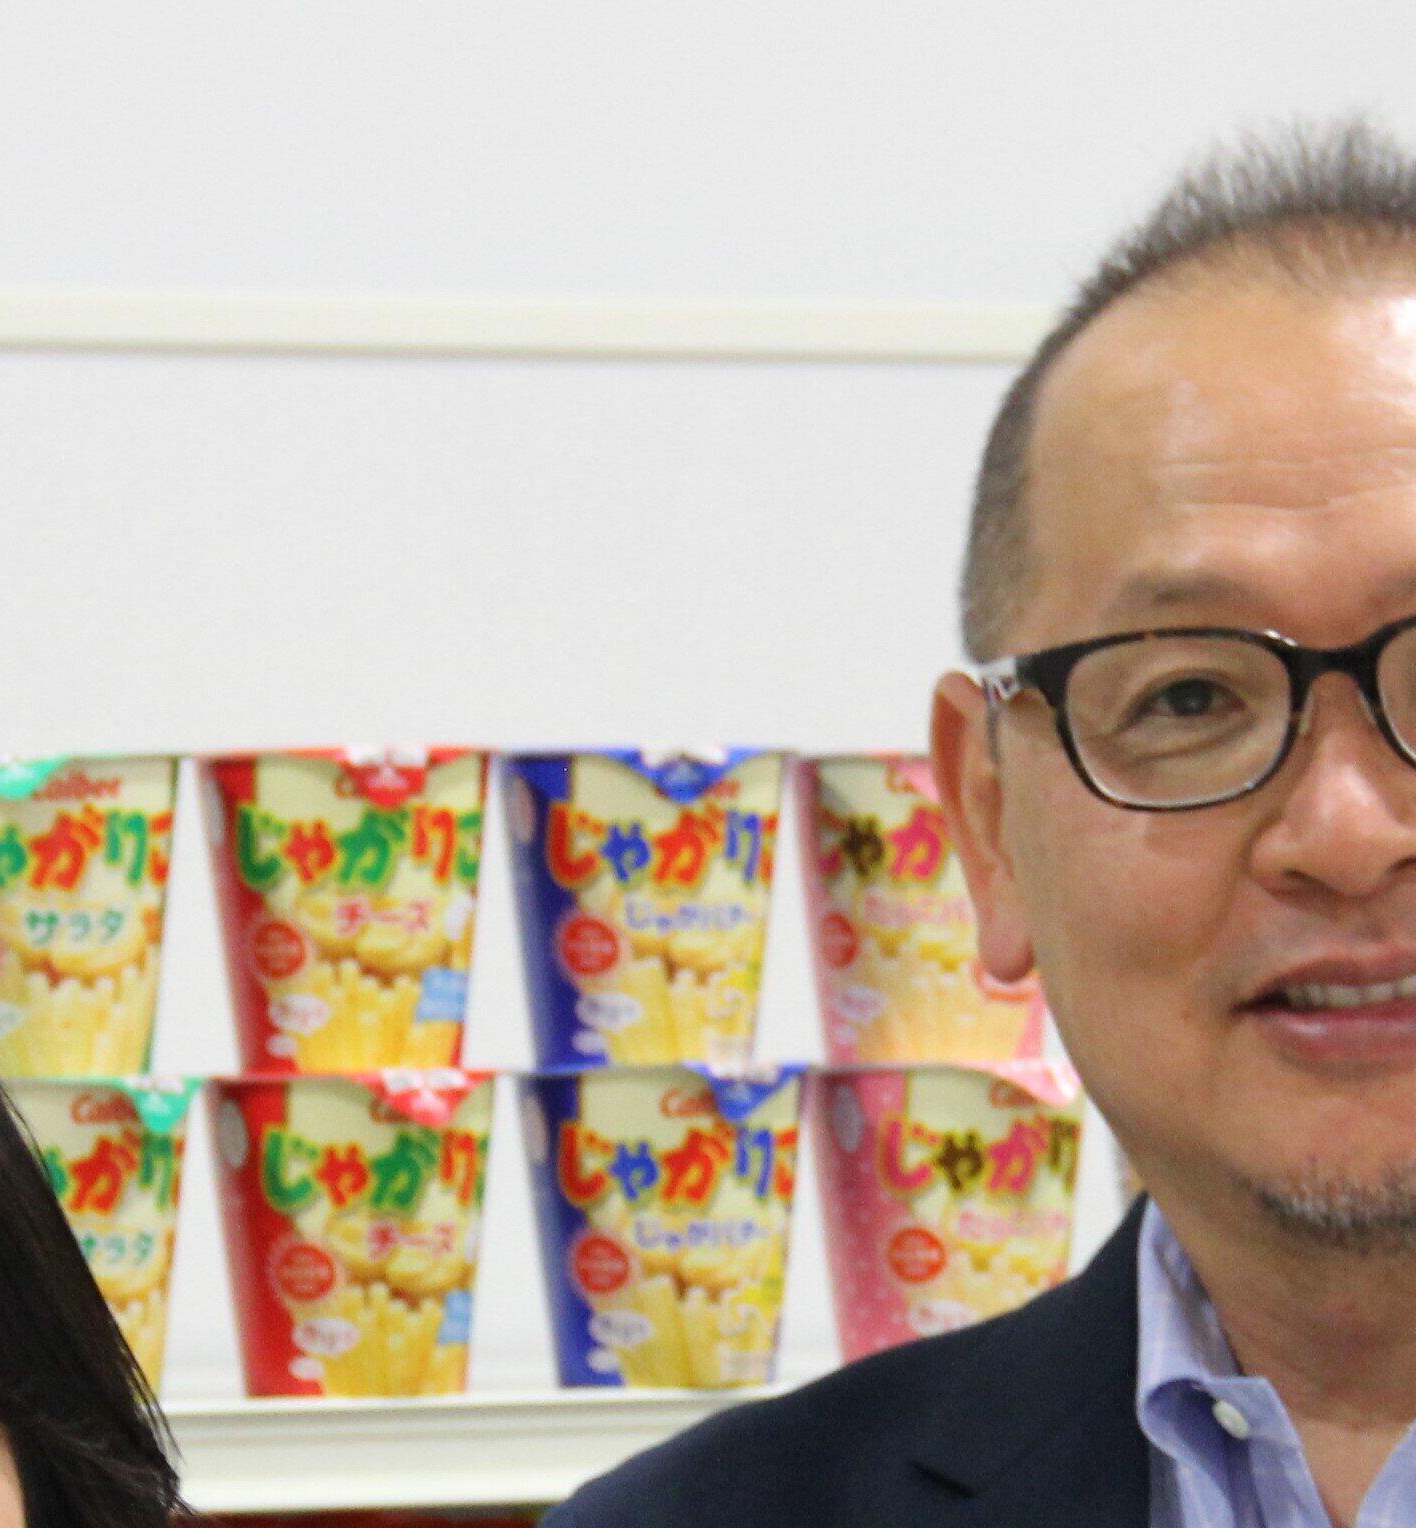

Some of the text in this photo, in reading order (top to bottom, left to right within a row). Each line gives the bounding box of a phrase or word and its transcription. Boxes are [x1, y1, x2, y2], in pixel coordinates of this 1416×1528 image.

[335, 903, 432, 936] チーズ
[265, 1126, 491, 1210] じゃがり
